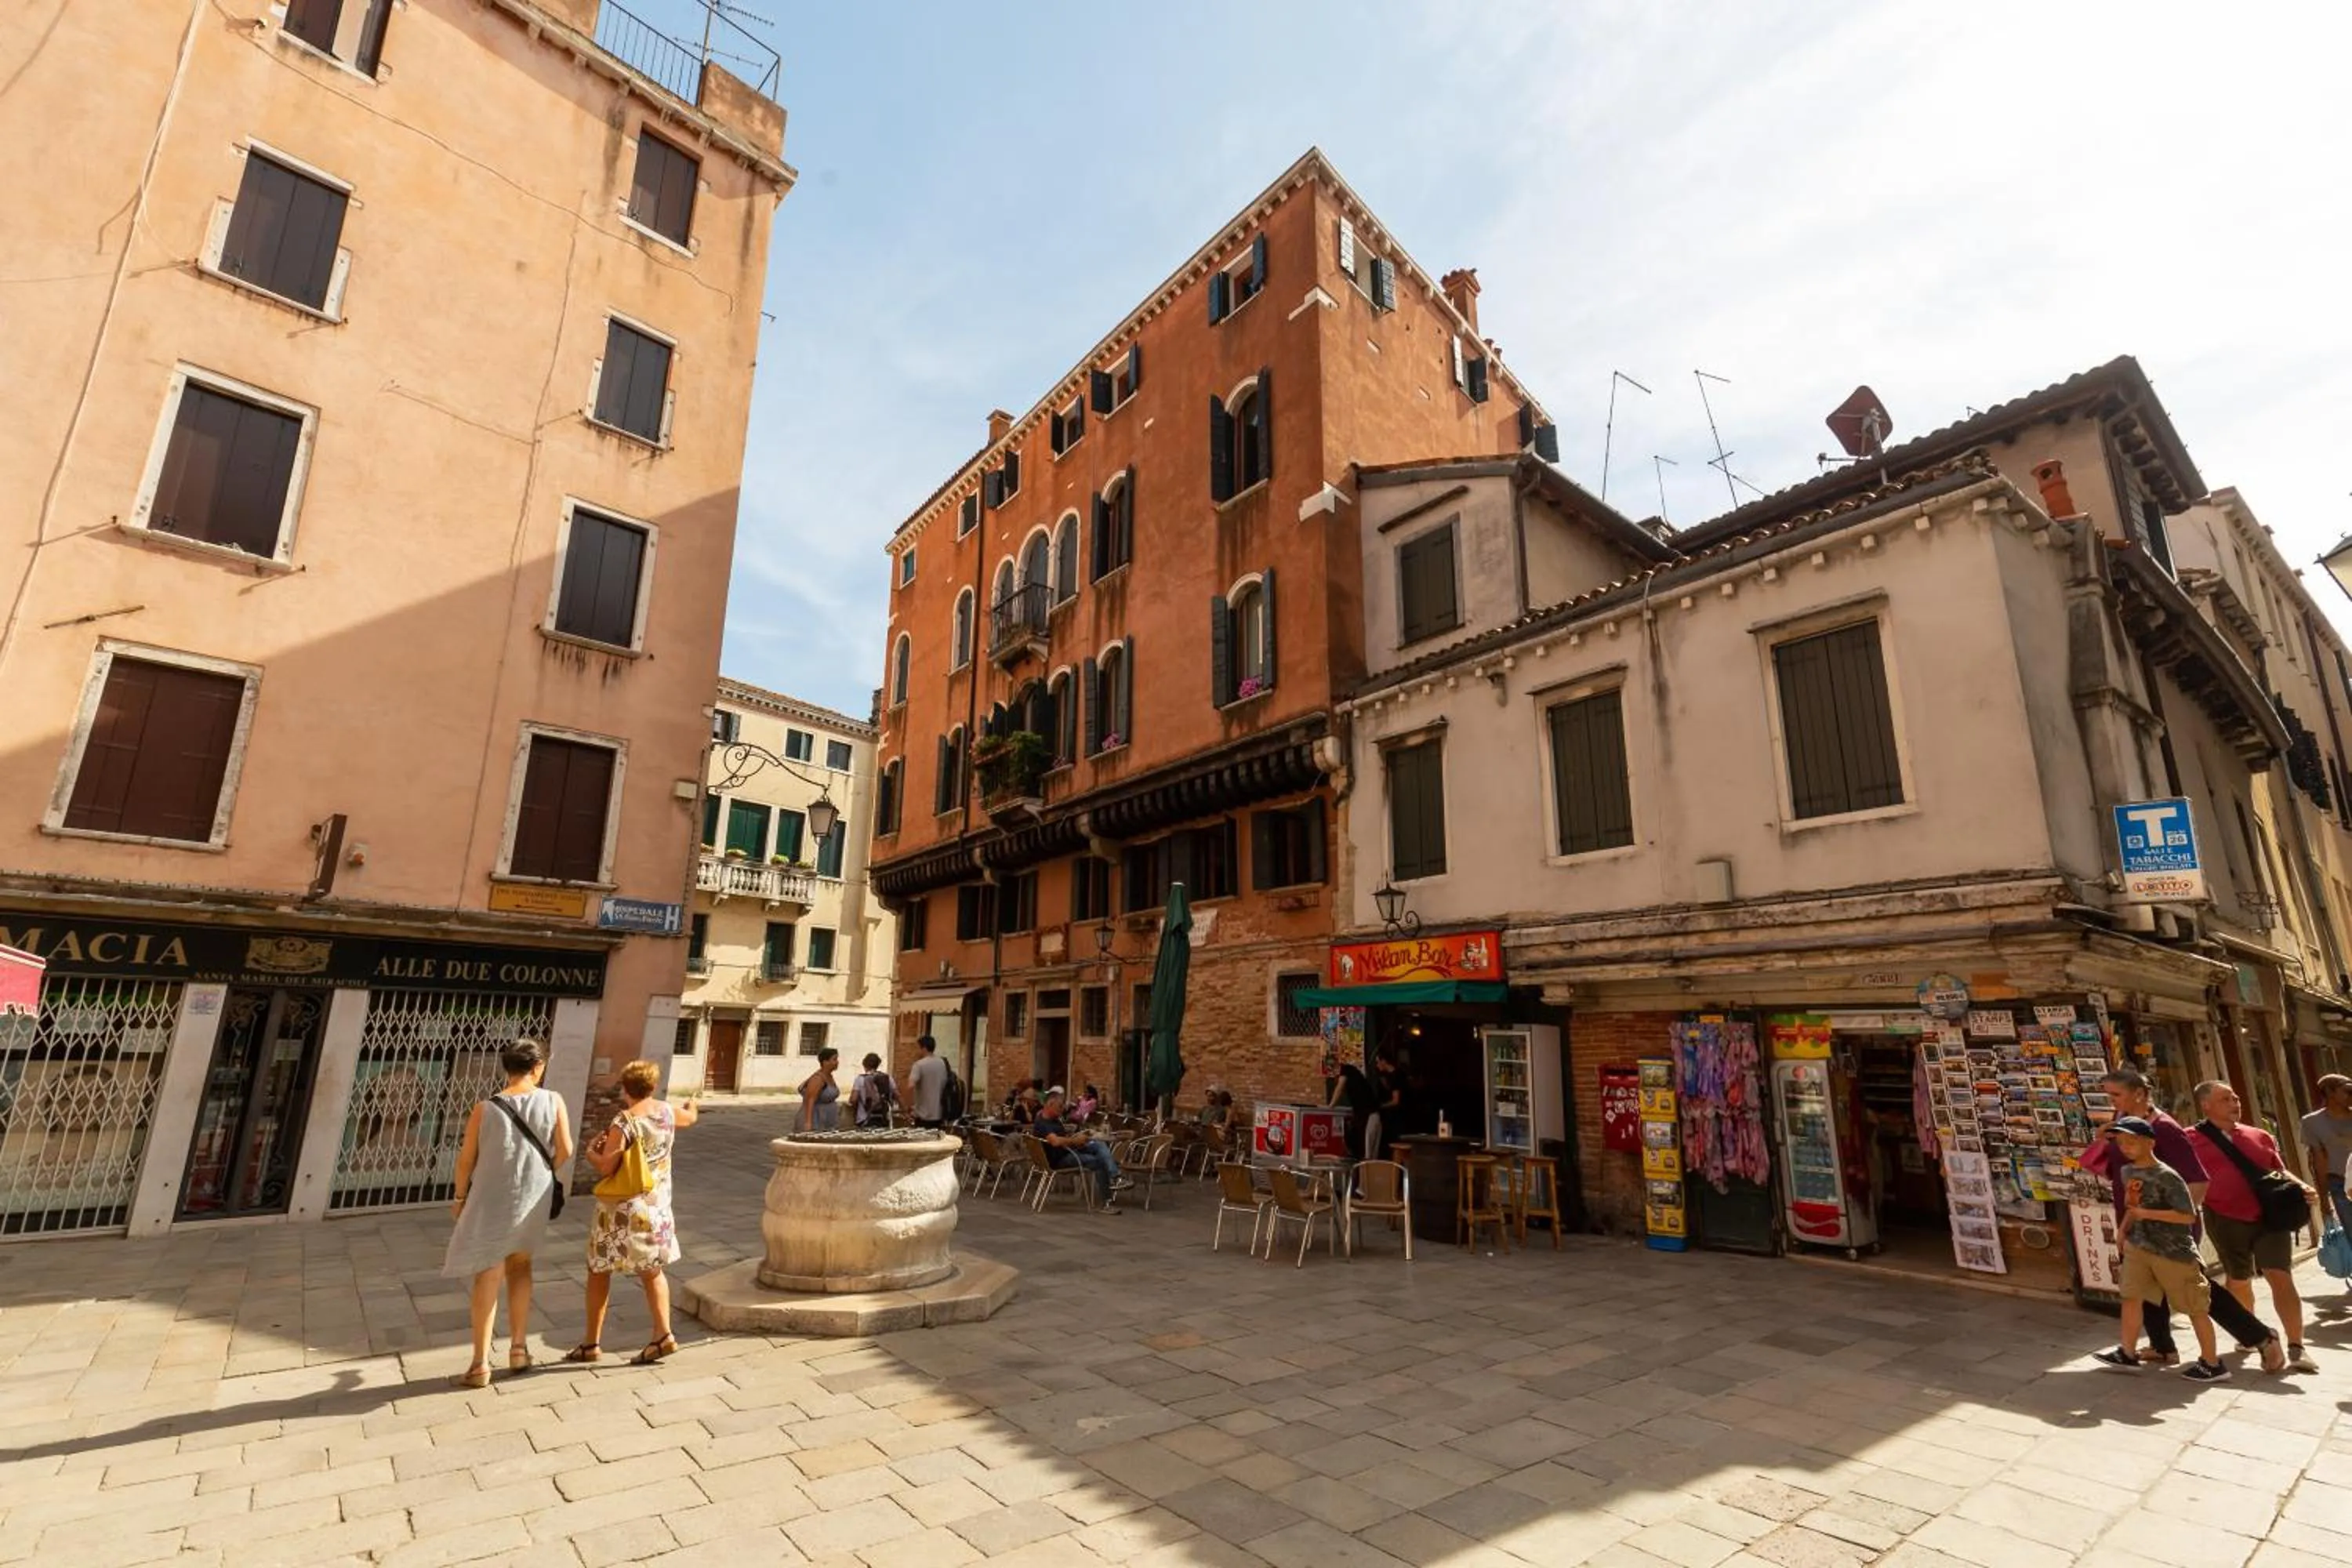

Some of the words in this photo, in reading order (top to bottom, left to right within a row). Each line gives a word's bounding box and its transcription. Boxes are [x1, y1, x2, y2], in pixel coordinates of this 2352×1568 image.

[2127, 807, 2177, 847] T
[2129, 852, 2191, 865] TABACCHI
[2134, 880, 2192, 892] LOTTO
[615, 906, 663, 916] OSPEDALE
[664, 906, 680, 931] H
[373, 955, 437, 978] ALLE
[444, 960, 492, 980] DUE
[499, 964, 601, 988] COLONNE
[1357, 946, 1414, 978] Milan
[1413, 941, 1454, 967] Bar
[1971, 1014, 2012, 1023] STAMPS
[2081, 1214, 2103, 1282] DRINKS
